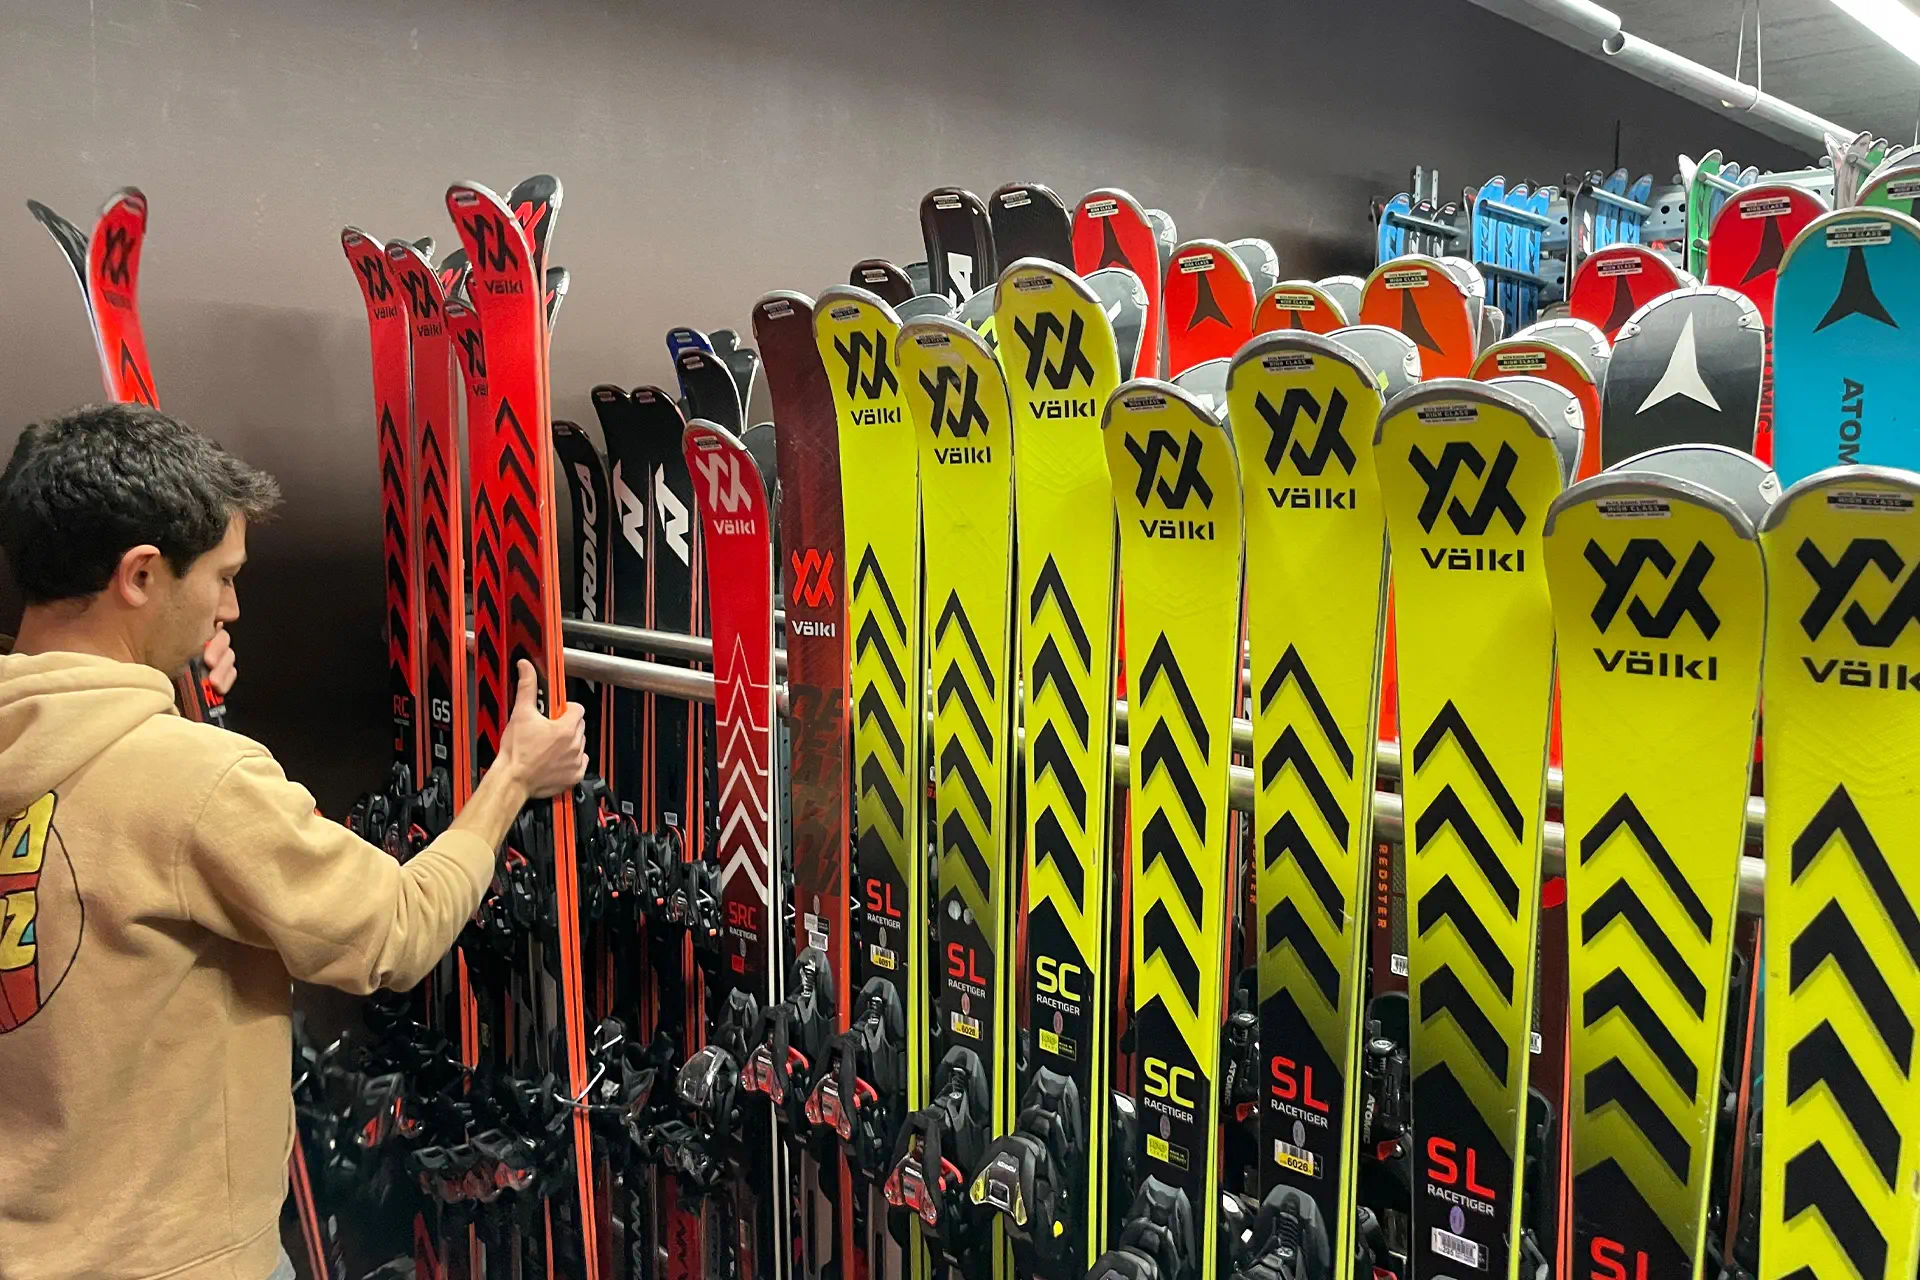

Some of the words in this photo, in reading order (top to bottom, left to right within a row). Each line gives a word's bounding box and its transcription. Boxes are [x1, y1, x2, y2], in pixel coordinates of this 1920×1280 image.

[485, 280, 524, 294] Völkl
[850, 407, 901, 426] Völkl
[1028, 398, 1097, 419] Völkl
[934, 446, 991, 465] Völkl
[1267, 487, 1356, 510] Völkl
[713, 519, 756, 535] Völkl
[1139, 519, 1215, 541] Völkl
[1420, 547, 1525, 572] Völkl
[791, 620, 837, 638] Völkl
[1592, 647, 1717, 681] Völkl
[1801, 656, 1920, 692] Völk
[432, 698, 450, 723] GS
[867, 878, 901, 917] SL
[1376, 844, 1390, 929] REDSTER
[728, 900, 757, 930] SRC
[867, 912, 901, 930] RACETIGER
[729, 926, 758, 942] RACETIGER
[947, 942, 986, 986] SL
[948, 978, 986, 999] RACETIGER
[1036, 955, 1081, 1002] SC
[1036, 993, 1080, 1016] RACETIGER
[1144, 1057, 1195, 1109] SC
[1271, 1055, 1329, 1113] SL
[1144, 1097, 1194, 1124] RACETIGER
[1271, 1098, 1329, 1129] RACETIGER
[1363, 1092, 1376, 1144] ATOMIC
[1427, 1136, 1496, 1200] SL
[1427, 1183, 1496, 1218] RACETIGER
